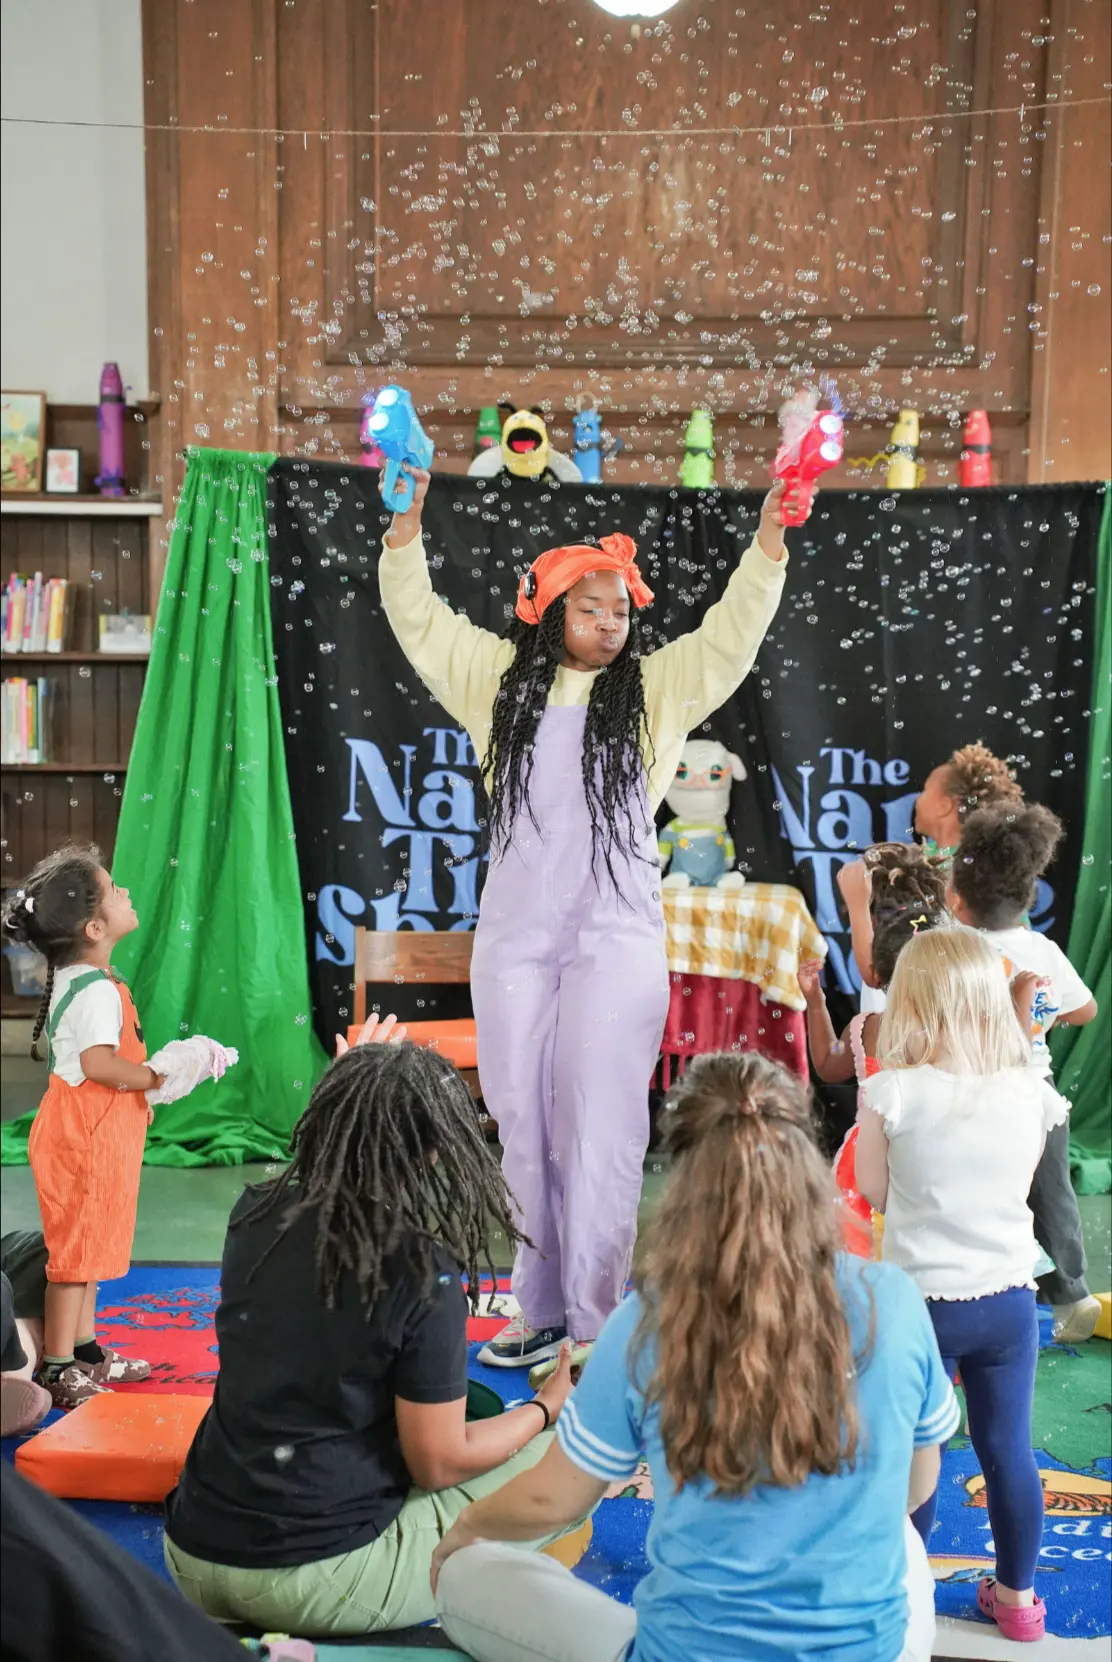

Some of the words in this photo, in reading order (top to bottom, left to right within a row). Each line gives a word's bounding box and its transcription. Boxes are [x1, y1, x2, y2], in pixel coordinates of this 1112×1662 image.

[422, 727, 480, 767] Th
[819, 747, 911, 785] The
[341, 737, 481, 832] Na
[382, 827, 490, 915] Ti
